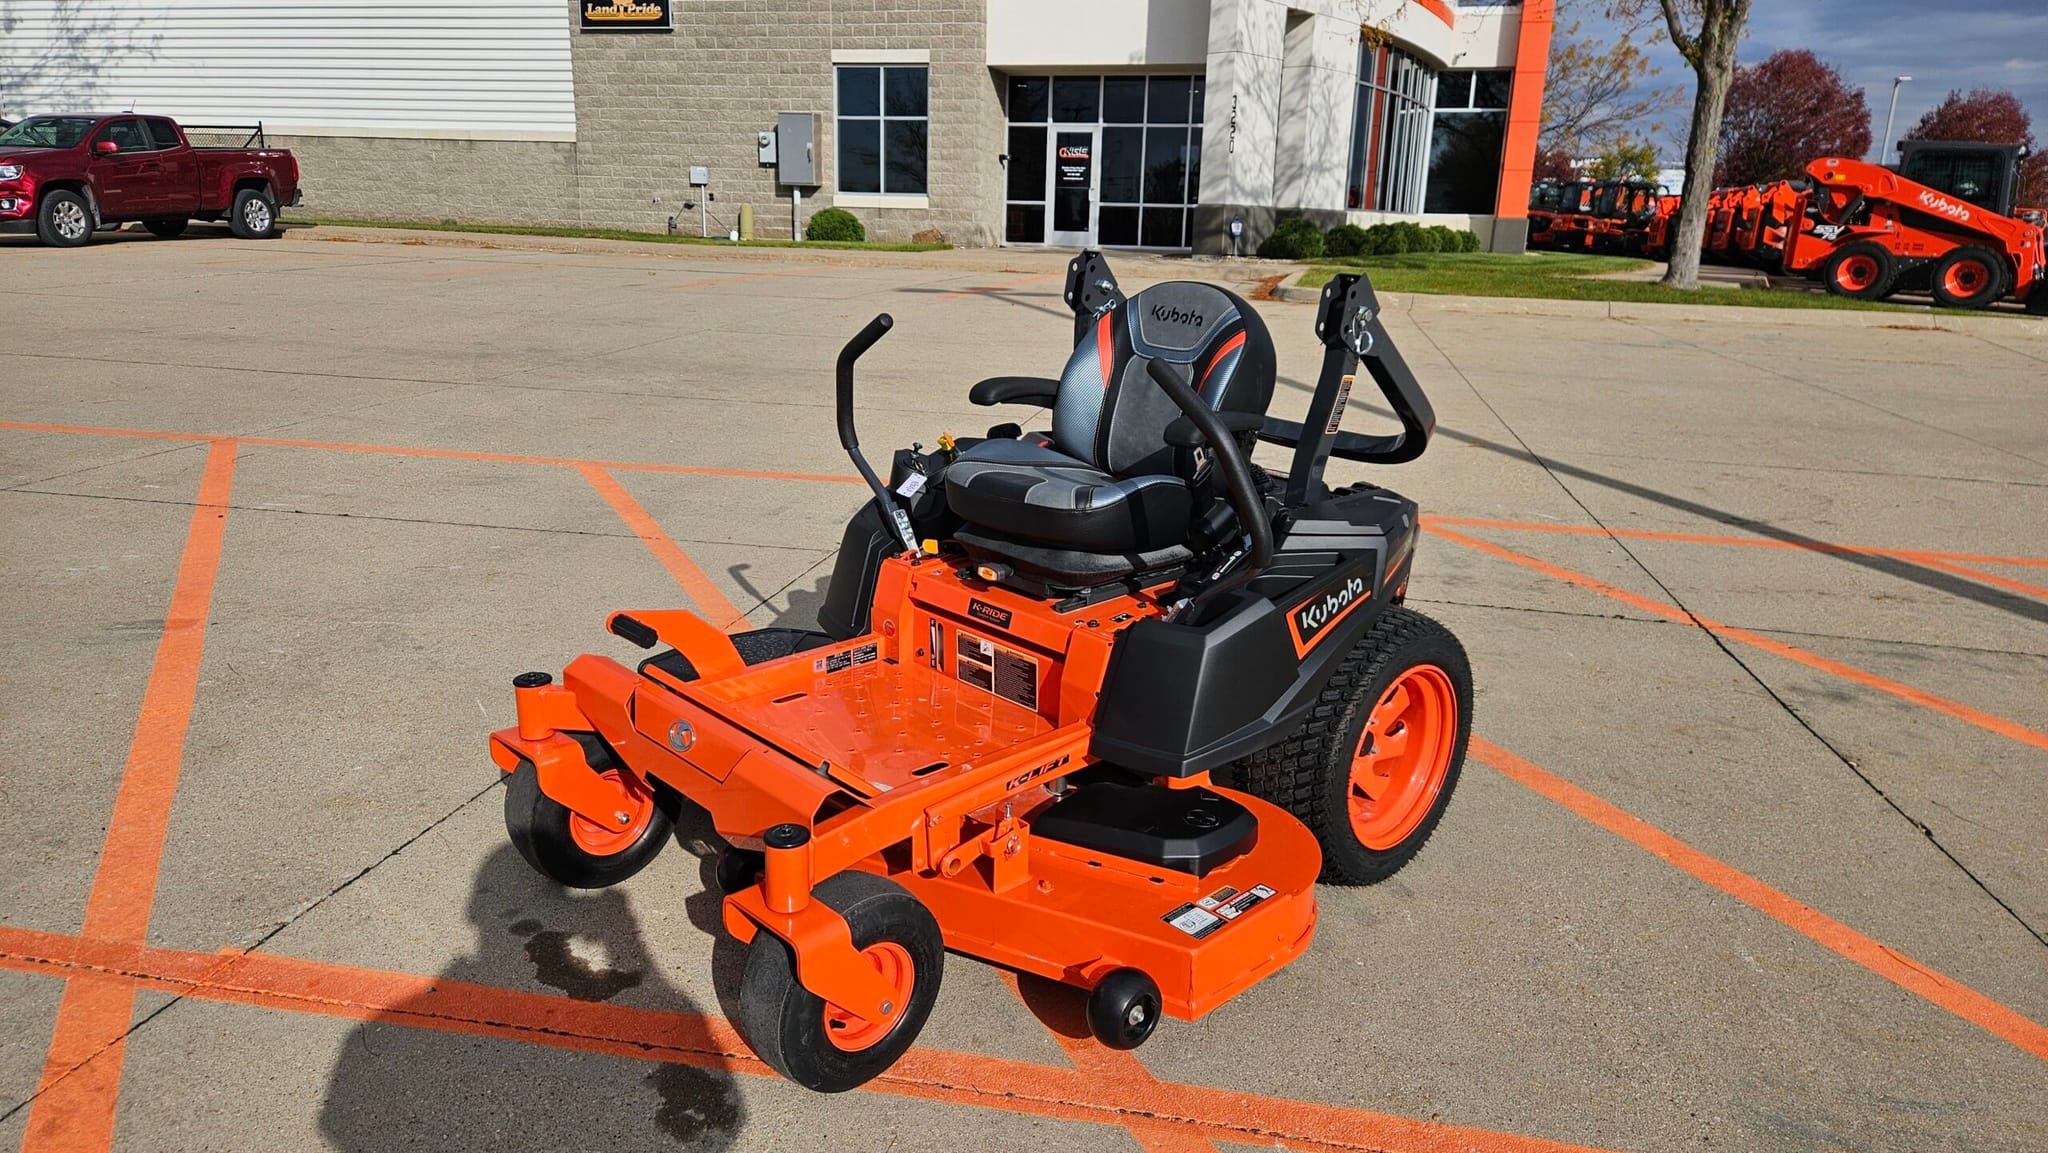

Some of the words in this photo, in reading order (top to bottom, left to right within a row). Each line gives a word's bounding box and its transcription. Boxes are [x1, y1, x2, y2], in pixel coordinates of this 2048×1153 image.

[587, 3, 618, 15] Land
[627, 3, 662, 15] Pride
[1919, 190, 1970, 221] Kubota
[1814, 224, 1846, 235] SSV
[1151, 304, 1204, 327] Kubota
[972, 602, 1009, 621] K-RIDE
[1301, 577, 1364, 629] Kubota
[1008, 755, 1068, 790] K-LIFT
